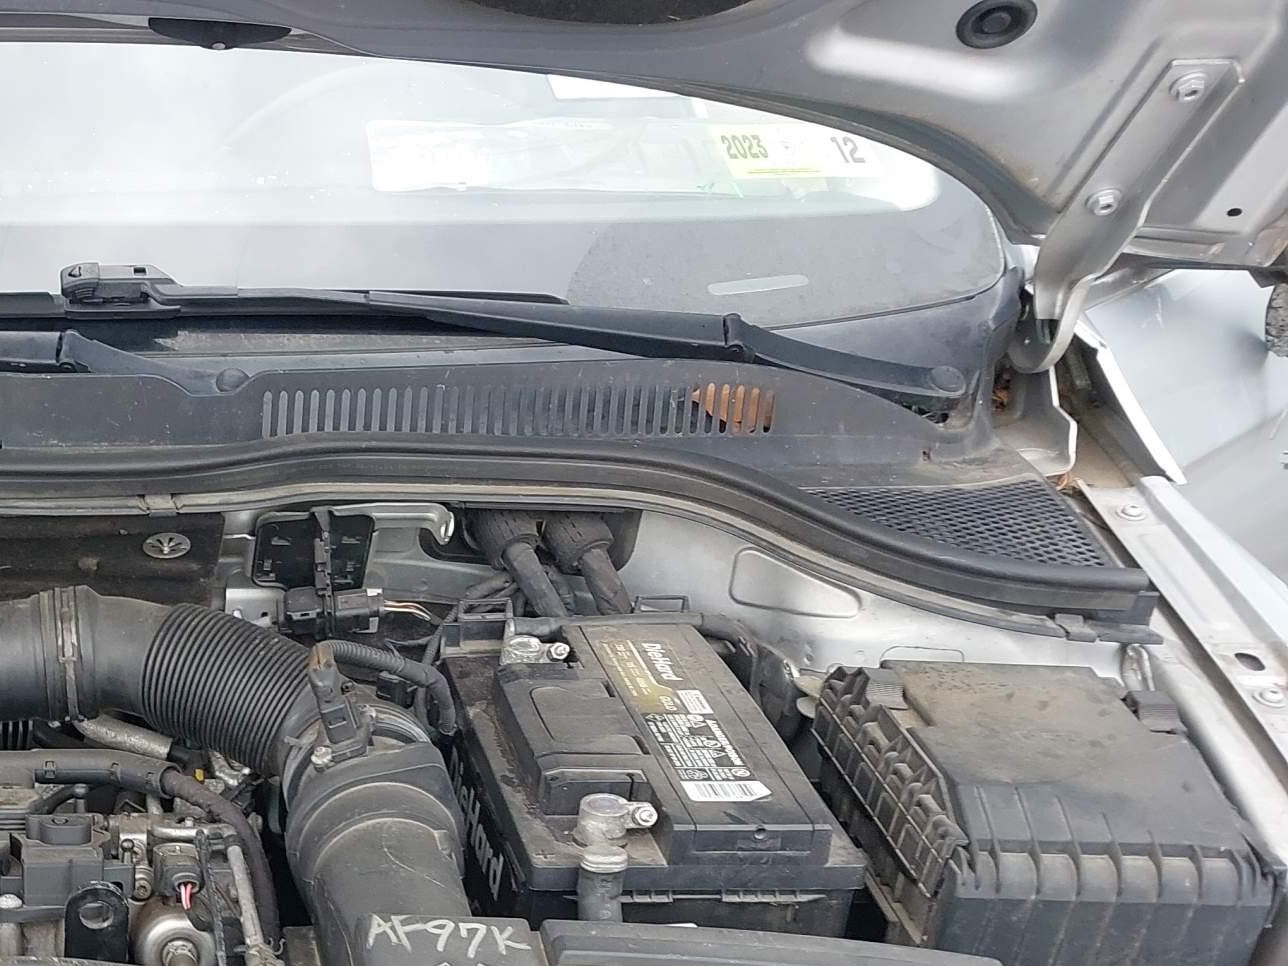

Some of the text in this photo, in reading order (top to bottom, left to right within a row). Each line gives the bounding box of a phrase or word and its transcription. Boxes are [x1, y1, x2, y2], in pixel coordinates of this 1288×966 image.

[720, 135, 769, 160] 2023
[830, 136, 865, 164] 12
[641, 642, 684, 681] DieHard
[365, 914, 532, 959] AF97K
